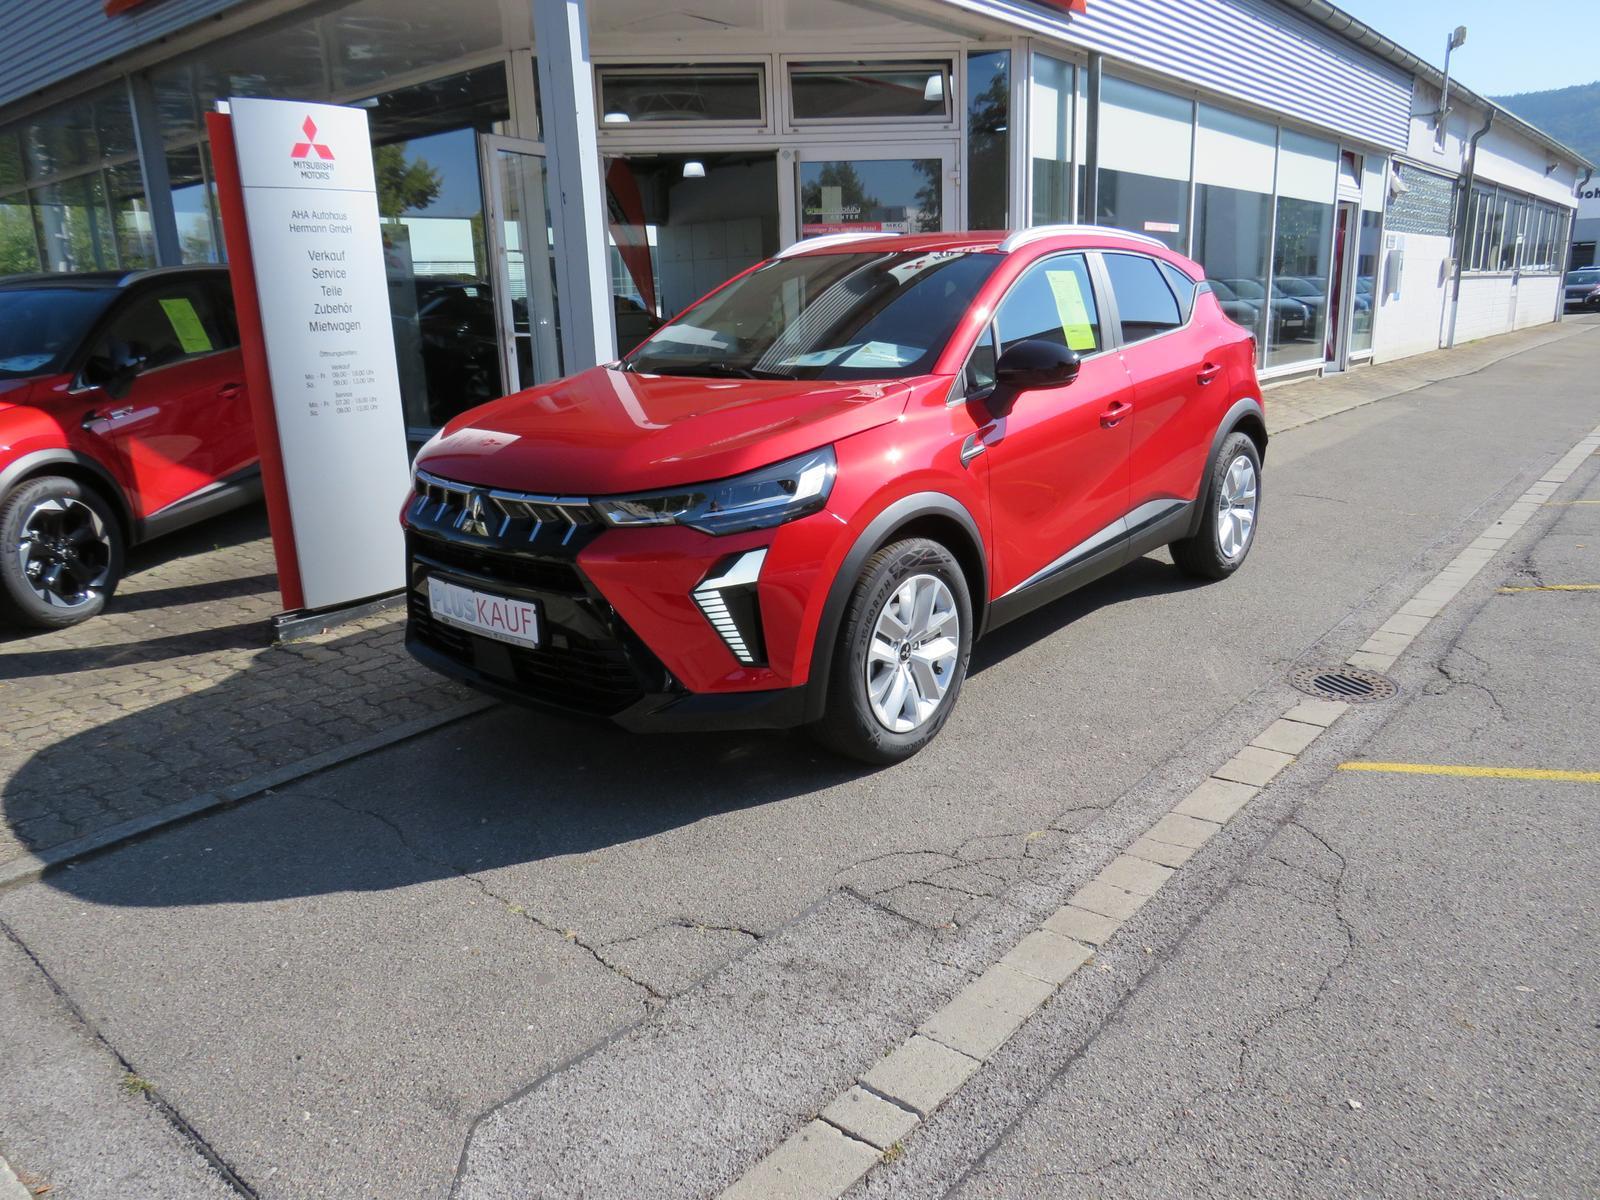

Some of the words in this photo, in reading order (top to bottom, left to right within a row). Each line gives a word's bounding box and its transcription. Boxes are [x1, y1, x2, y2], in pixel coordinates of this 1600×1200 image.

[293, 161, 334, 171] MITSUBISHI
[300, 171, 330, 180] MOTORS
[291, 210, 309, 220] AHA
[312, 210, 348, 221] Autohaus
[289, 224, 327, 233] Hermann
[329, 223, 352, 234] GmbH
[307, 250, 346, 261] Verkauf
[311, 267, 347, 279] Service
[320, 285, 343, 297] Teile
[314, 302, 353, 315] Zubehör
[309, 321, 361, 334] Mietwagen
[872, 599, 880, 609] R
[884, 579, 891, 590] H
